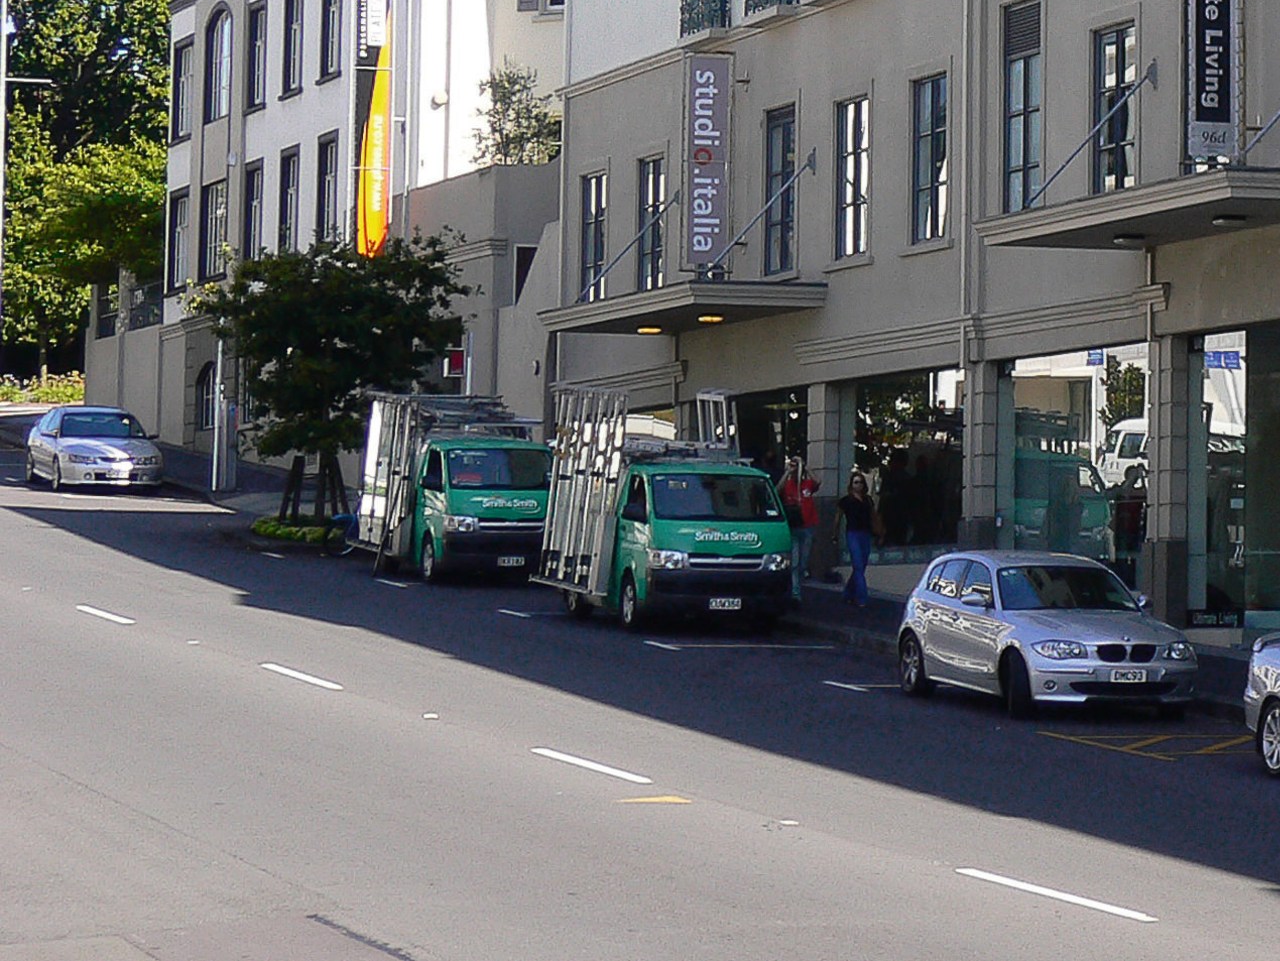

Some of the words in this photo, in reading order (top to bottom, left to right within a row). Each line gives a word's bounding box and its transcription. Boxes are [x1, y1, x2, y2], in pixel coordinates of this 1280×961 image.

[1201, 29, 1224, 109] Living
[693, 71, 720, 251] studio.italia
[1202, 131, 1227, 144] 96d
